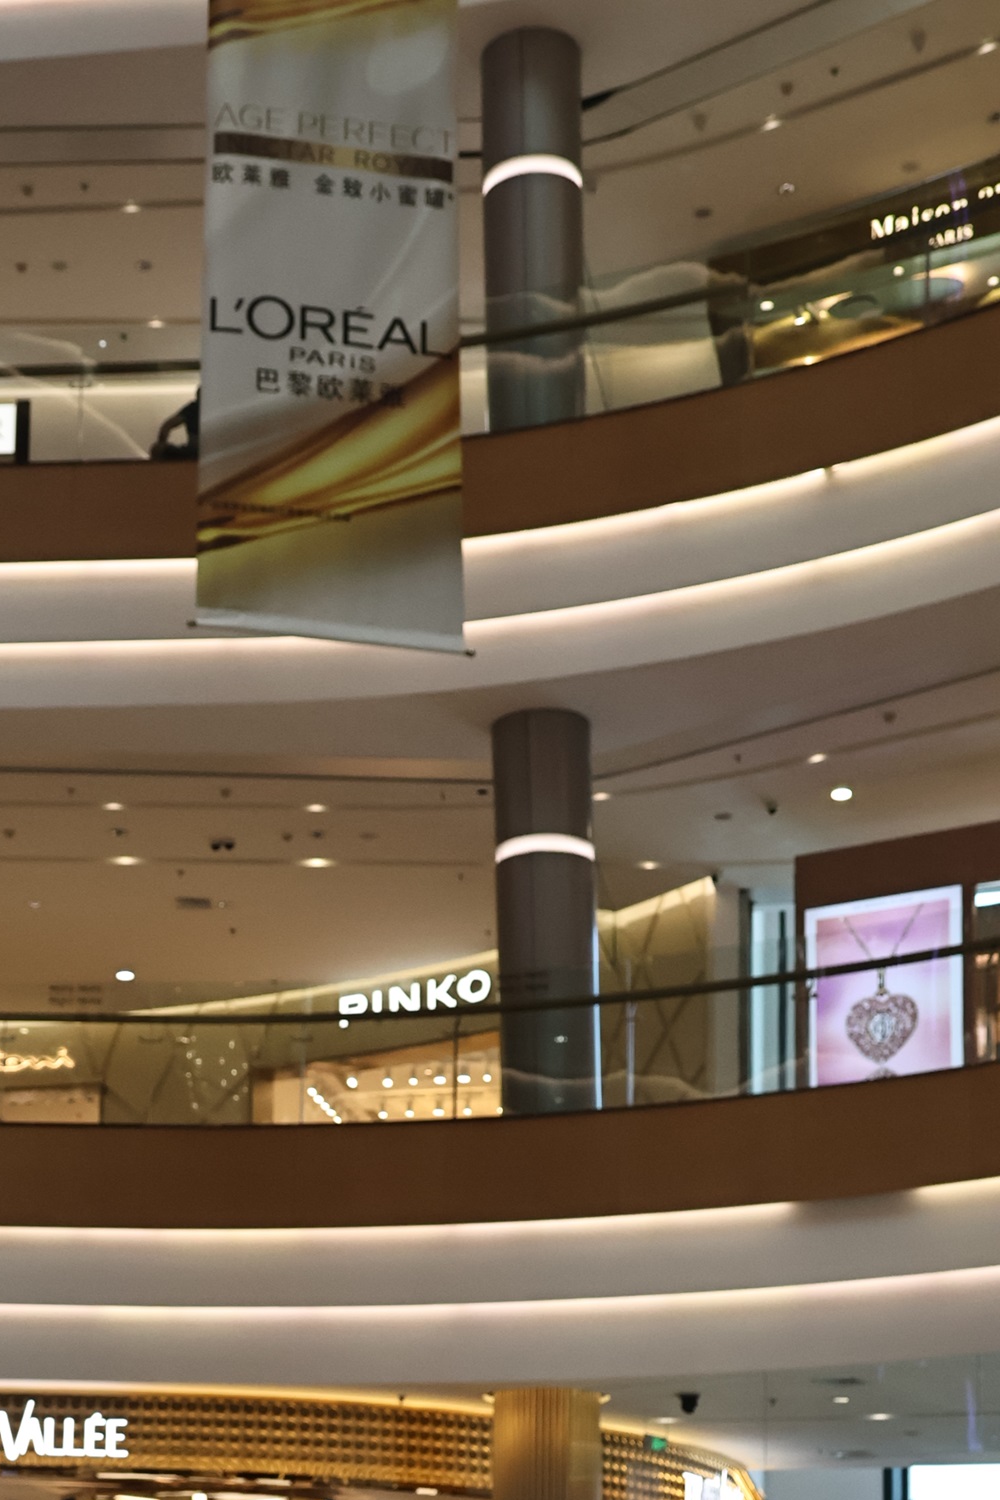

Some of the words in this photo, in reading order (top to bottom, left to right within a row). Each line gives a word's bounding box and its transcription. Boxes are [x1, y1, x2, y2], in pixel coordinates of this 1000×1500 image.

[213, 102, 284, 132] AGE
[297, 111, 454, 154] PERFECT
[209, 295, 453, 360] L'ORÉAL
[338, 969, 492, 1029] PINKO
